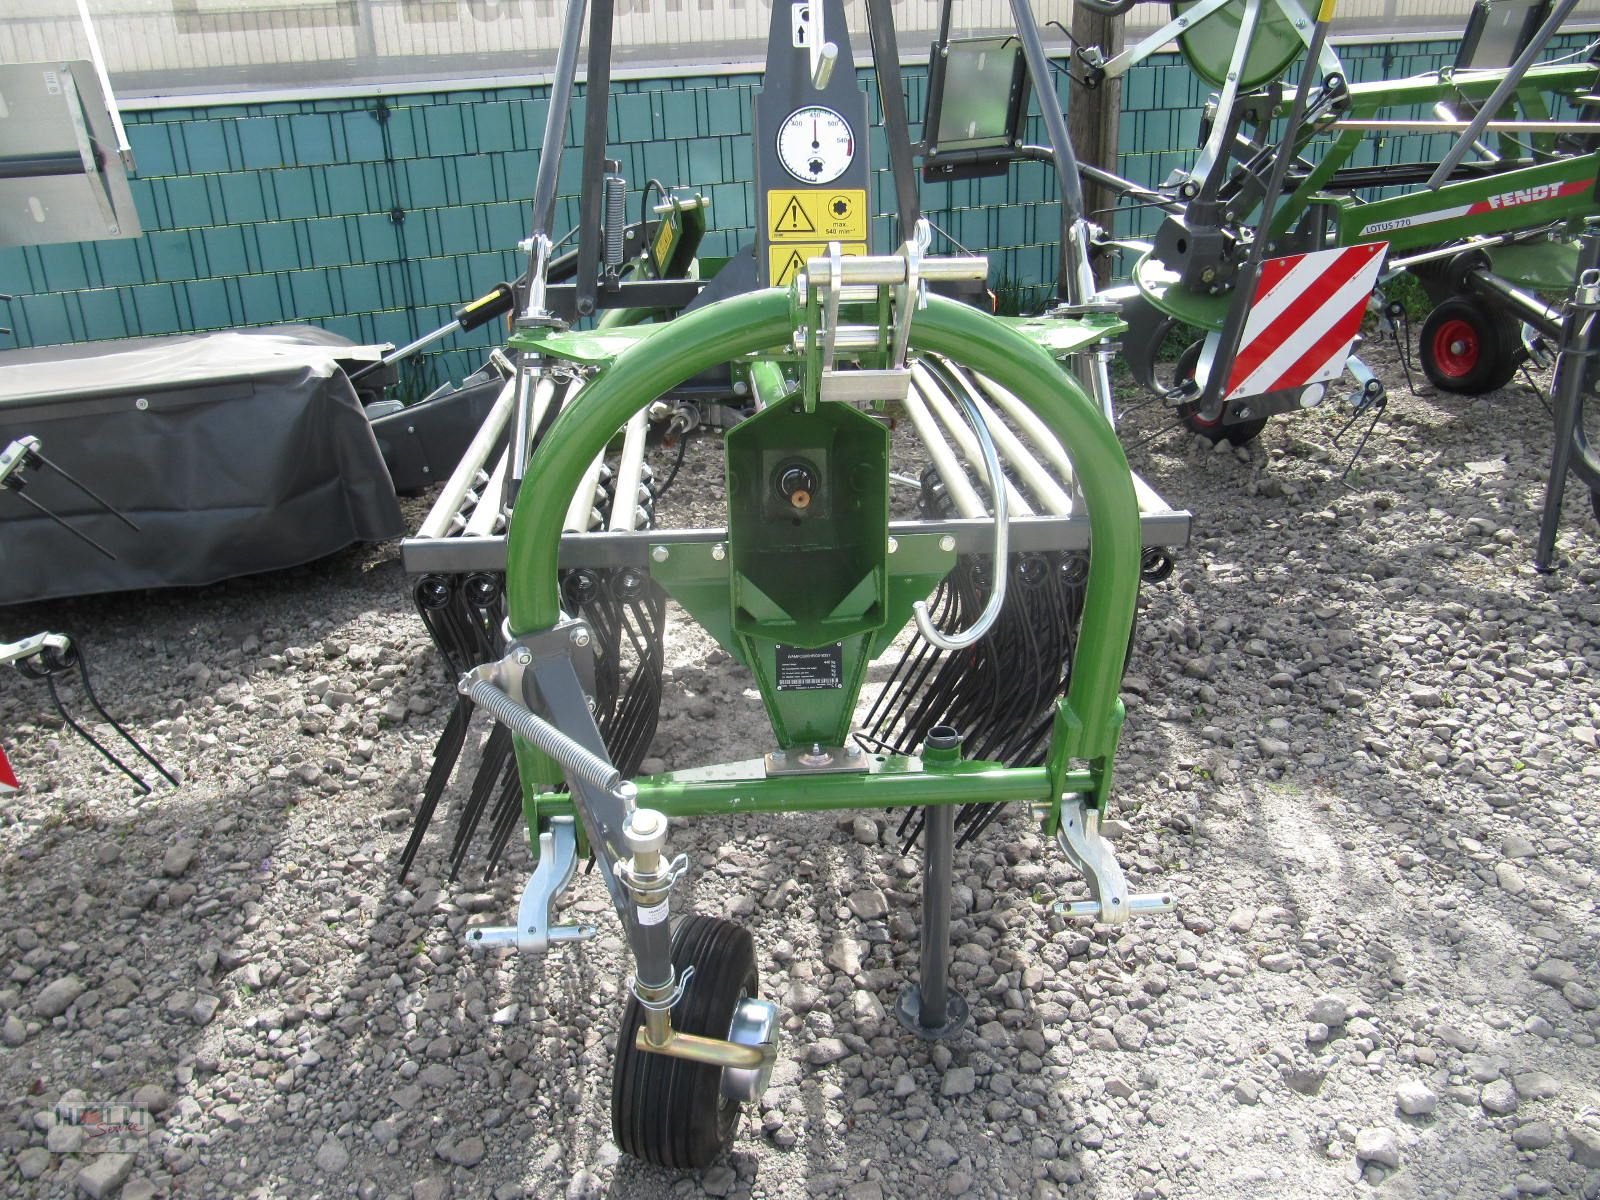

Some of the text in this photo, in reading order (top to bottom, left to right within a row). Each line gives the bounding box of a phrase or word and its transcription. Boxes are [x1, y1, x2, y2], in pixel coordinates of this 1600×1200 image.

[1487, 181, 1565, 209] FENDT
[1366, 218, 1411, 234] LOTUS 770
